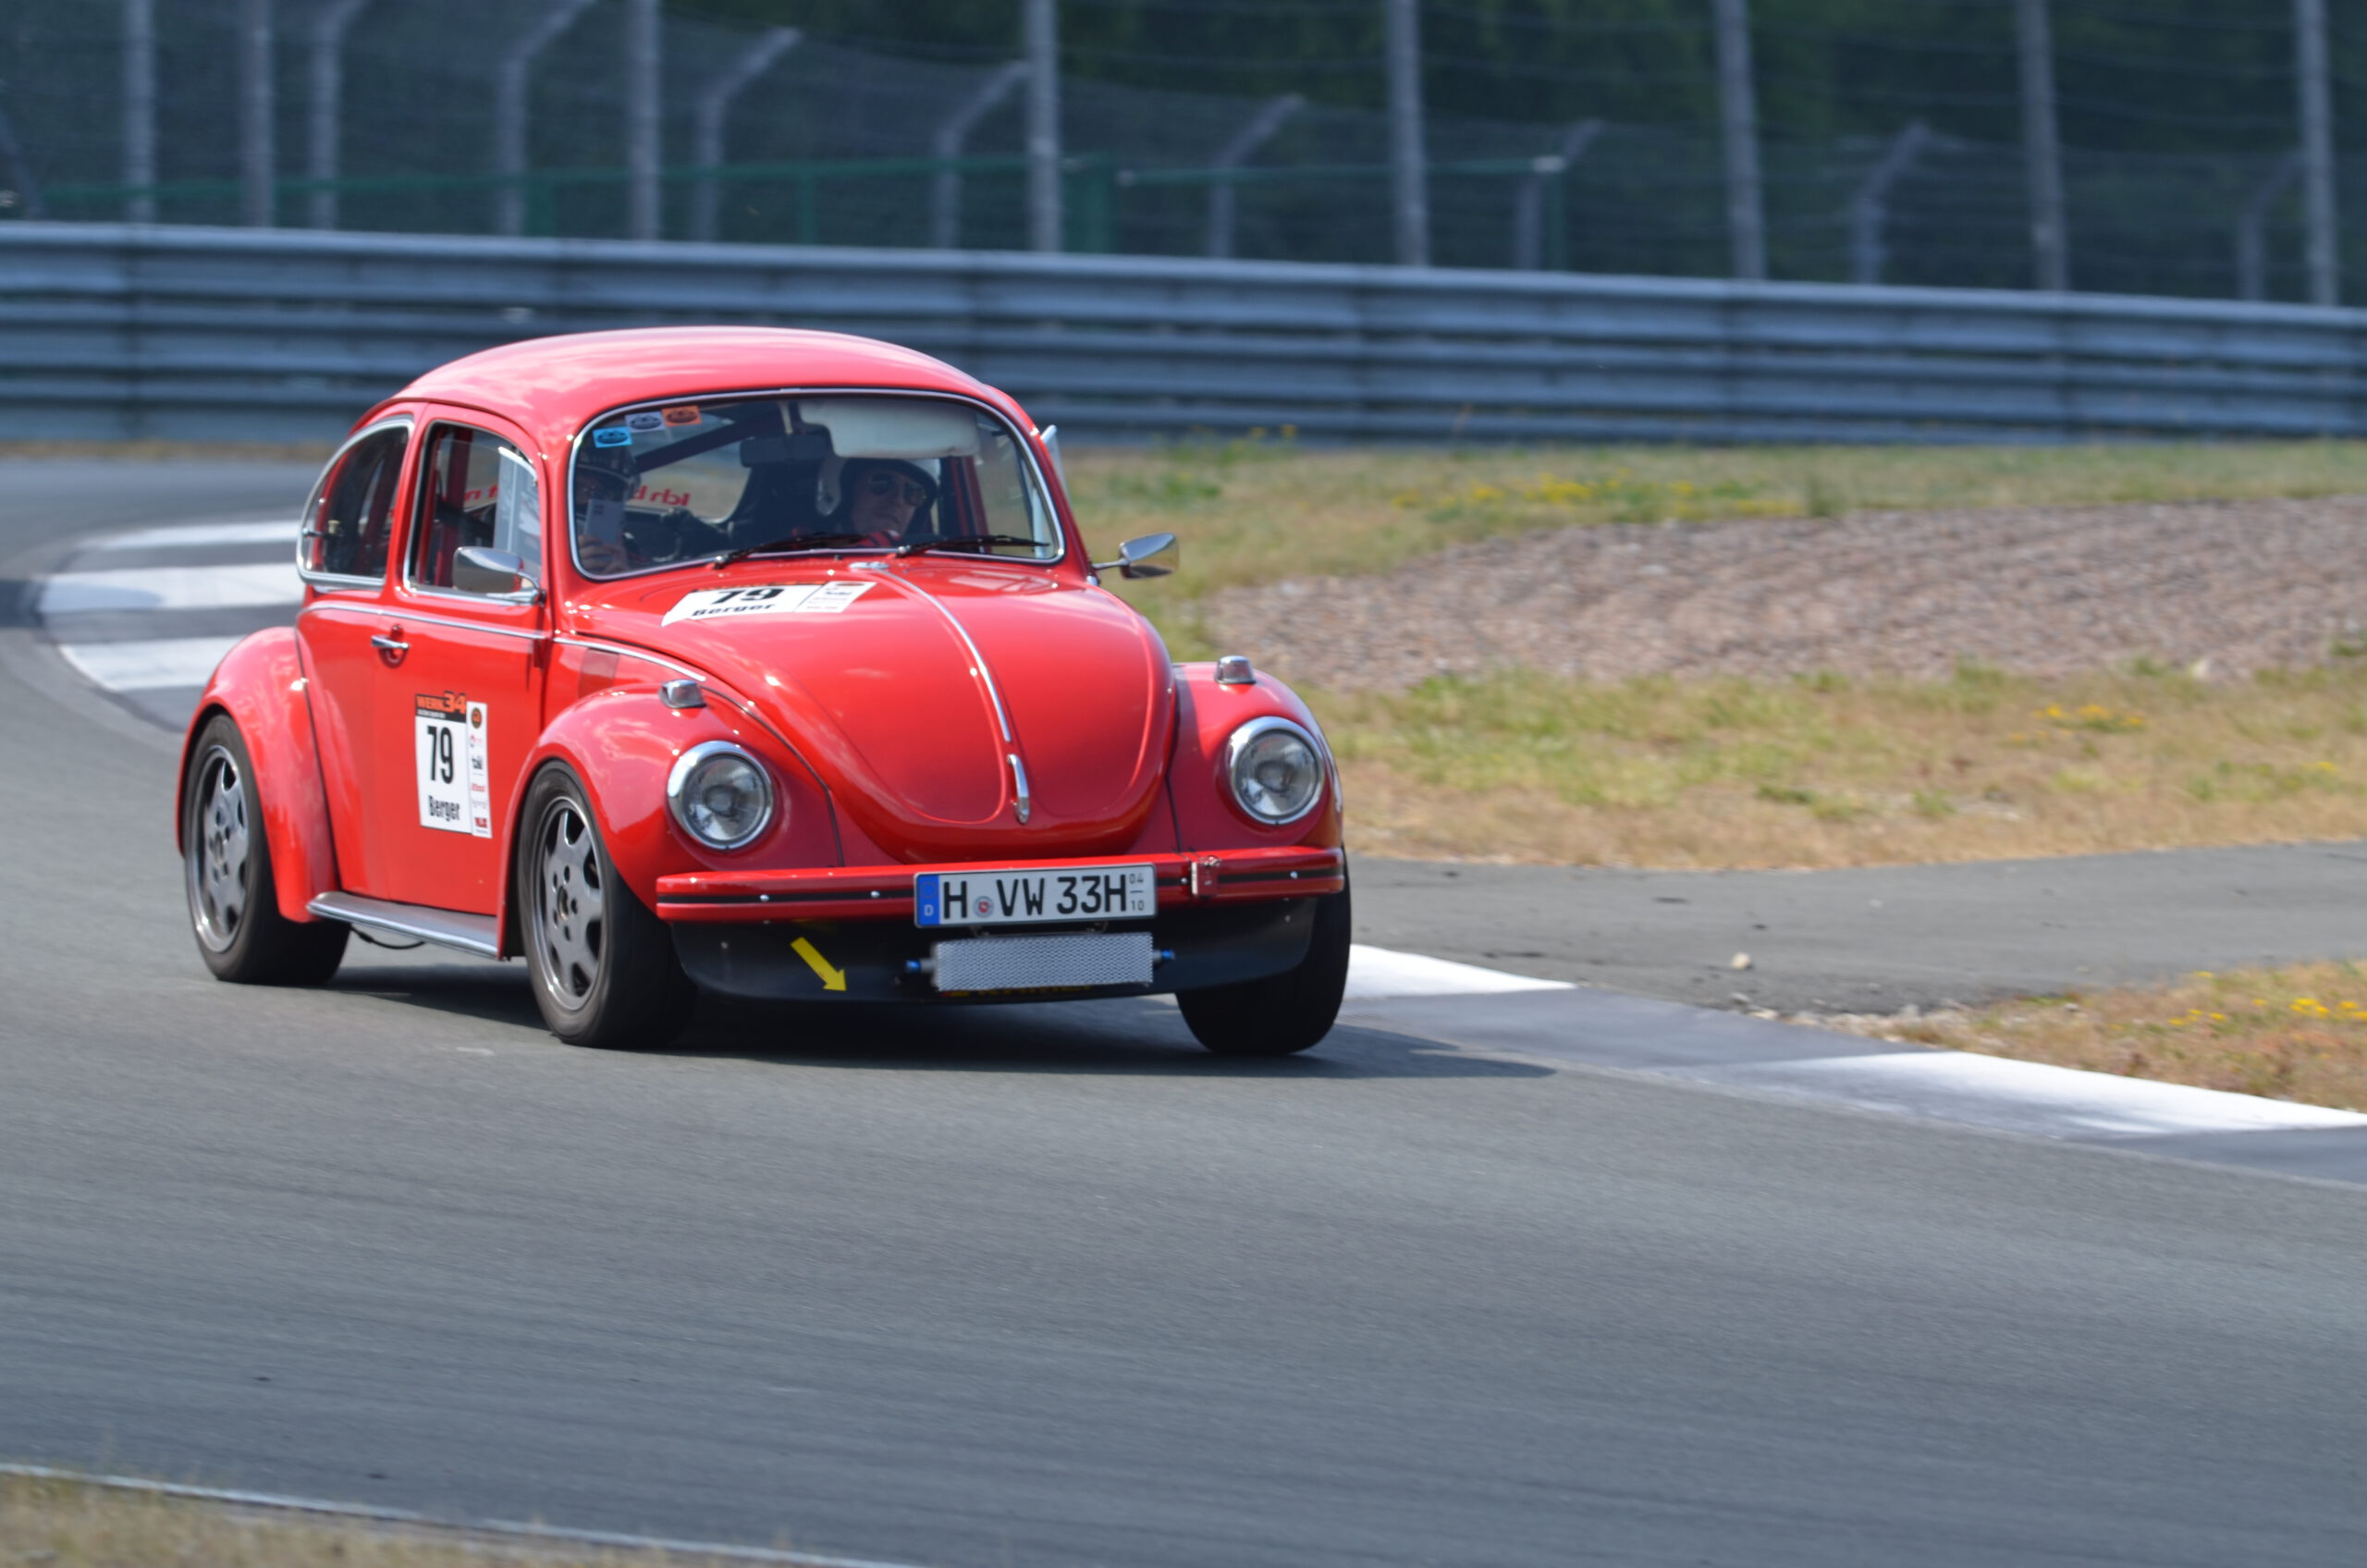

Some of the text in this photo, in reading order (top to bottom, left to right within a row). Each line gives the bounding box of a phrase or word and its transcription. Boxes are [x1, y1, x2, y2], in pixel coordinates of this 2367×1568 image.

[711, 588, 785, 606] 79
[692, 604, 776, 617] Berger
[427, 726, 453, 785] 79
[428, 795, 460, 821] Berger
[1129, 873, 1144, 884] 04
[943, 875, 1126, 919] H VW 33H
[925, 905, 933, 916] D
[1131, 900, 1145, 912] 10
